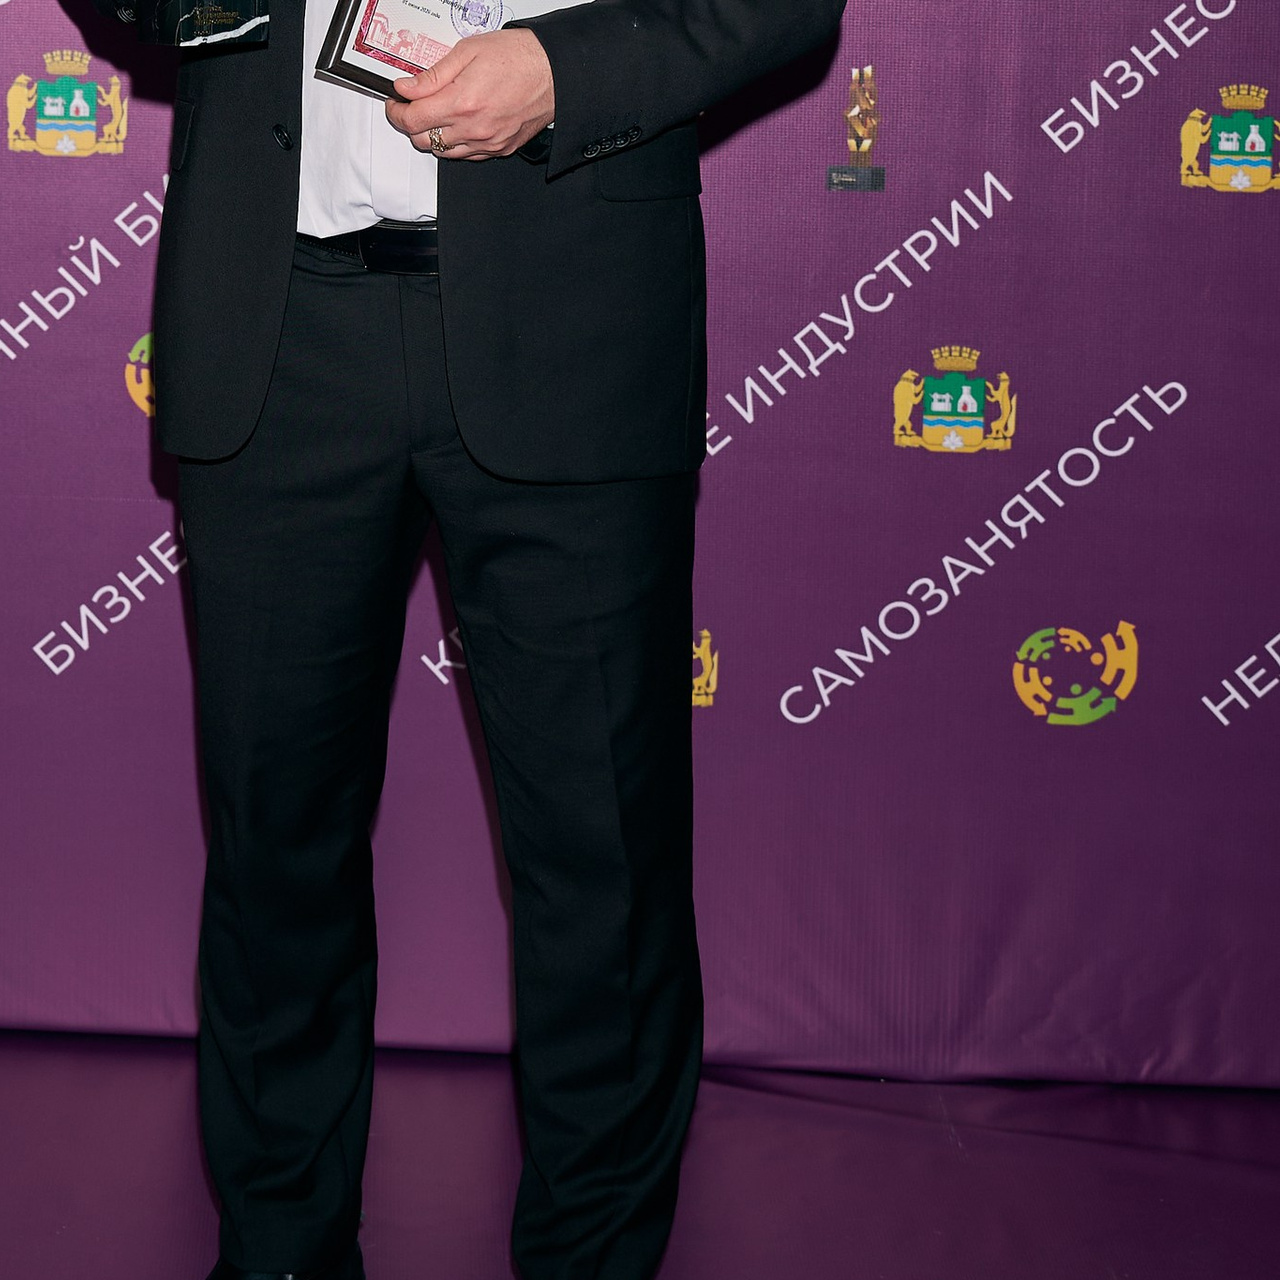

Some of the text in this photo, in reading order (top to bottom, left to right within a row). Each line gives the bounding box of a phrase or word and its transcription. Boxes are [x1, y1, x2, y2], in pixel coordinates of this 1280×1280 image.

[724, 170, 1013, 424] ИНДУСТРИИ
[32, 528, 187, 675] БИЗНЕ
[779, 381, 1188, 725] САМОЗАНЯТОСТЬ
